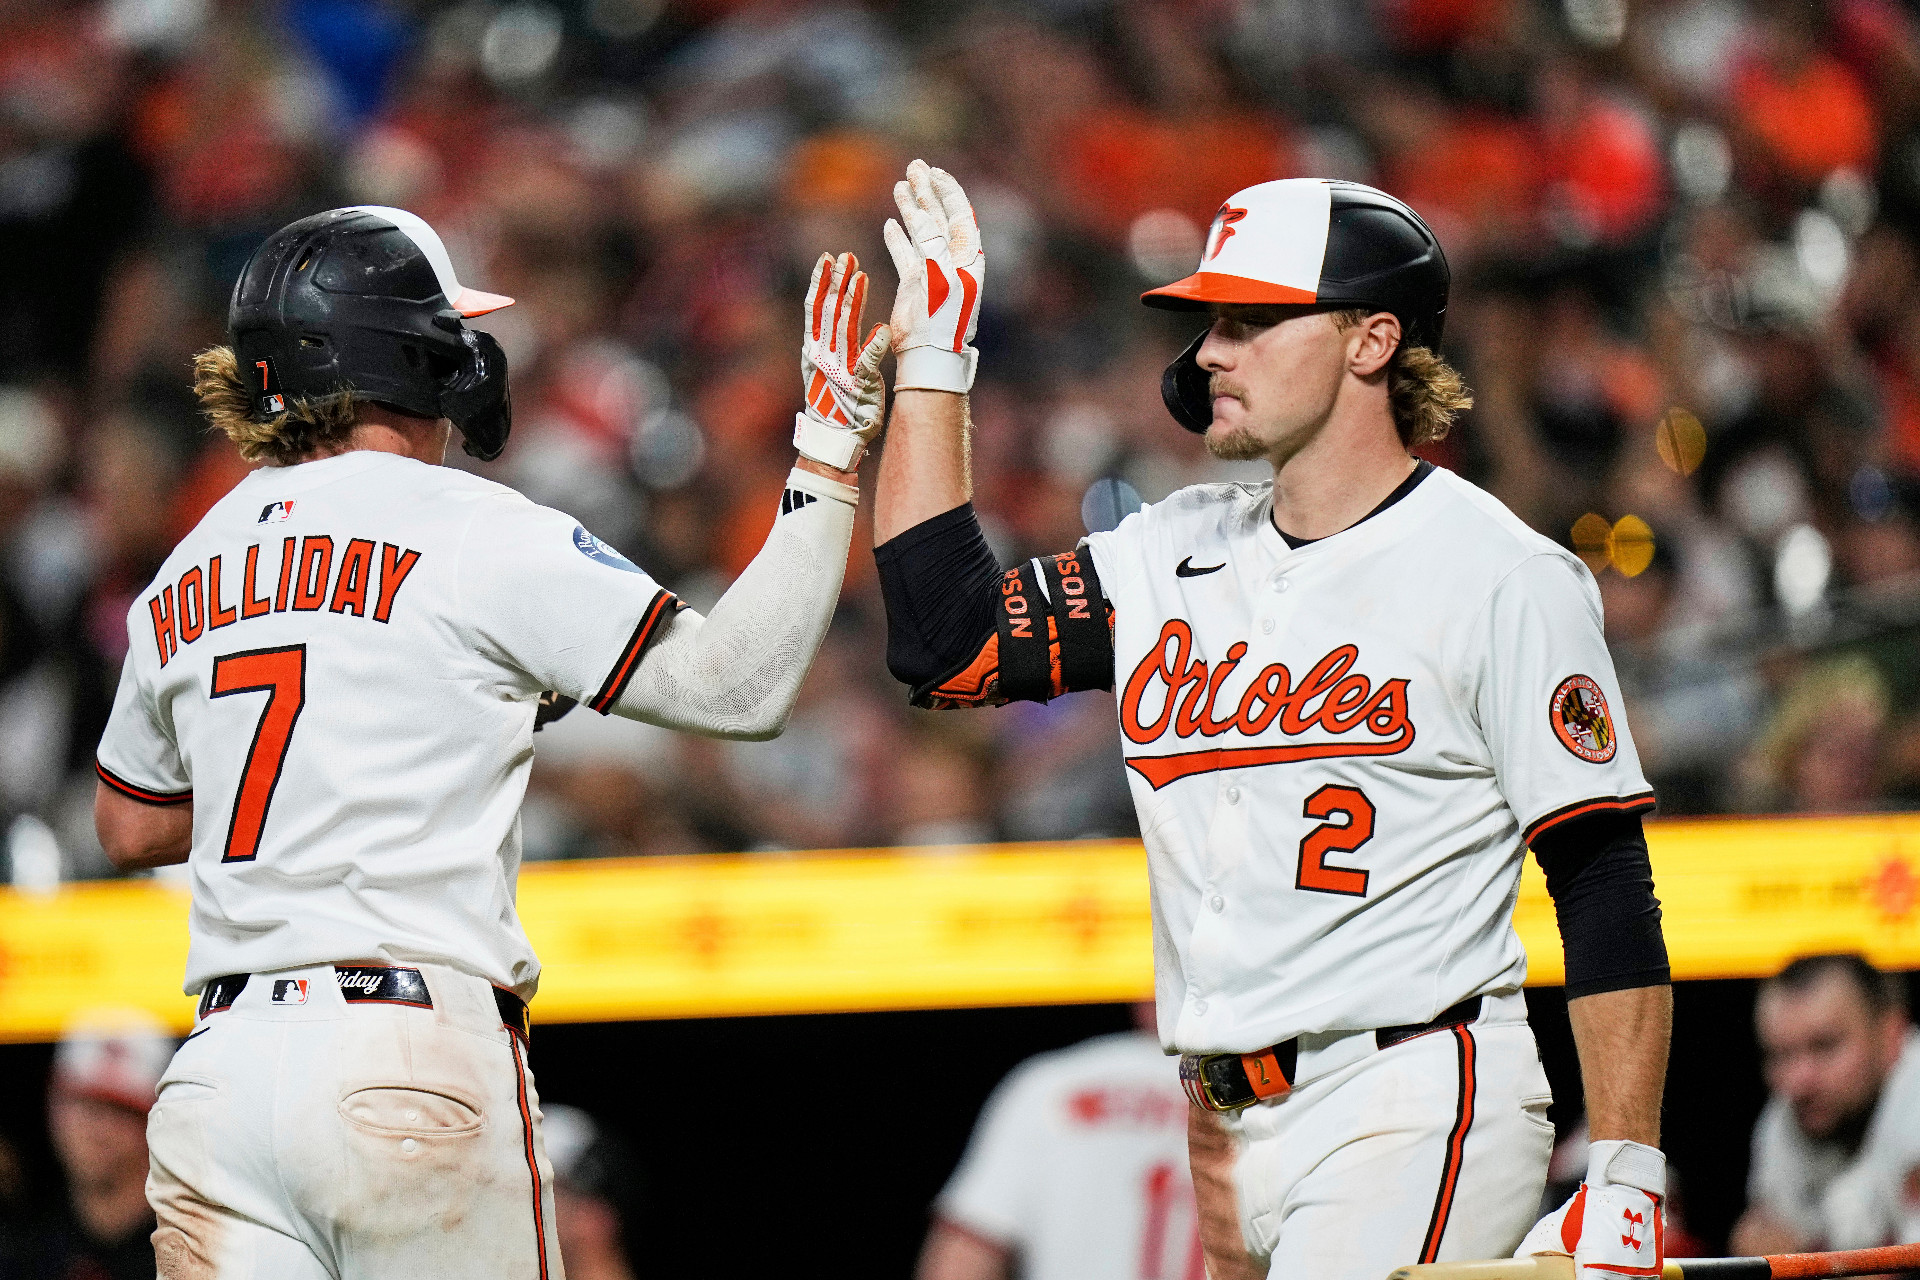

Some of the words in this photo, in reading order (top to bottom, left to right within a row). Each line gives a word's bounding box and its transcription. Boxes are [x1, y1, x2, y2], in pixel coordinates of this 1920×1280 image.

[255, 360, 269, 391] 7
[148, 534, 422, 669] HOLLIDAY
[1120, 618, 1416, 754] Orioles
[1553, 679, 1604, 712] BALTIMORE
[210, 643, 307, 864] 7
[1575, 740, 1615, 759] ORIOLES
[1295, 783, 1377, 898] 2
[1253, 1058, 1271, 1086] 2
